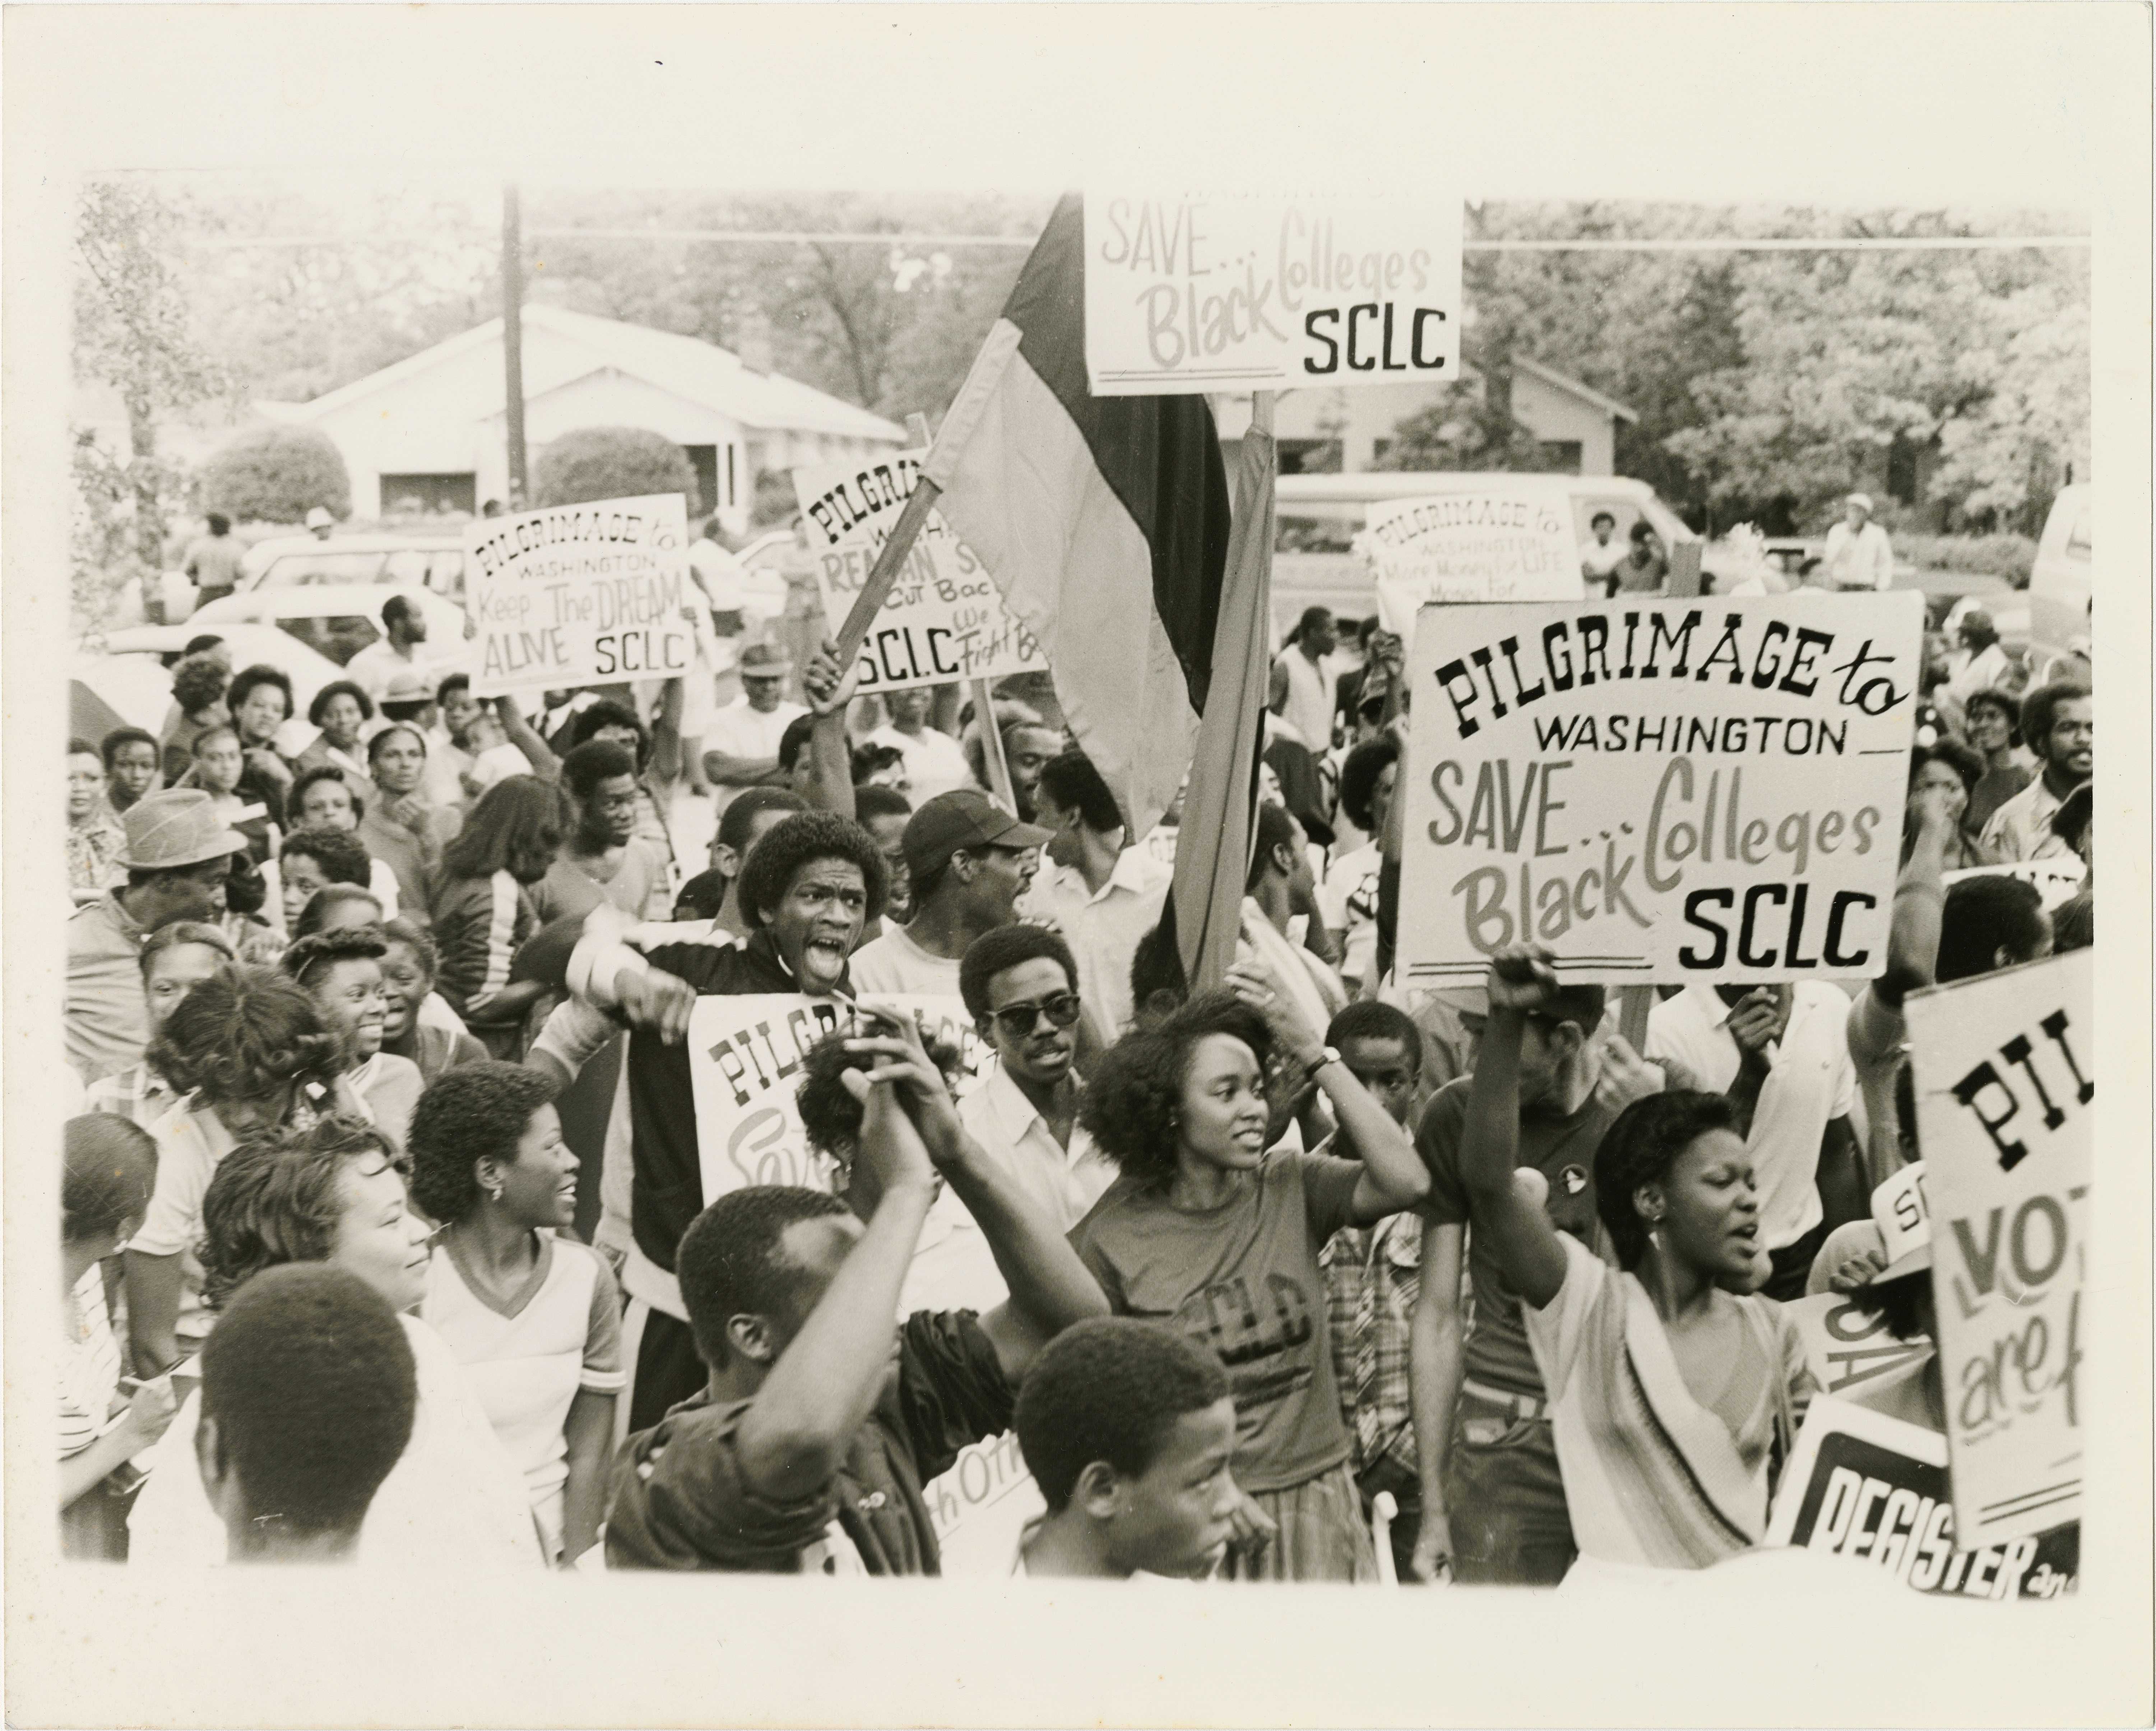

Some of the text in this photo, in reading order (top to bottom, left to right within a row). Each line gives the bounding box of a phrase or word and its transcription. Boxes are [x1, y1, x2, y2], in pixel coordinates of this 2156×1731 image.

[1278, 205, 1431, 311] Colleges
[1135, 261, 1446, 374] Black SCLC
[808, 460, 920, 544] PILGRI
[1375, 500, 1560, 546] PILGRIMAGE to
[476, 512, 675, 576] PILGRIMAGE to
[518, 554, 655, 578] WASHINGTON
[821, 545, 937, 593] REAAN
[478, 571, 682, 632] Keep The DREAM
[483, 626, 685, 677] ALIVE SCLC
[1434, 611, 1911, 740] PILGRIMAGE to
[1533, 715, 1846, 756] WASHINGTON
[1645, 756, 1882, 892] Colleges
[1451, 840, 1876, 970] Black SCLC
